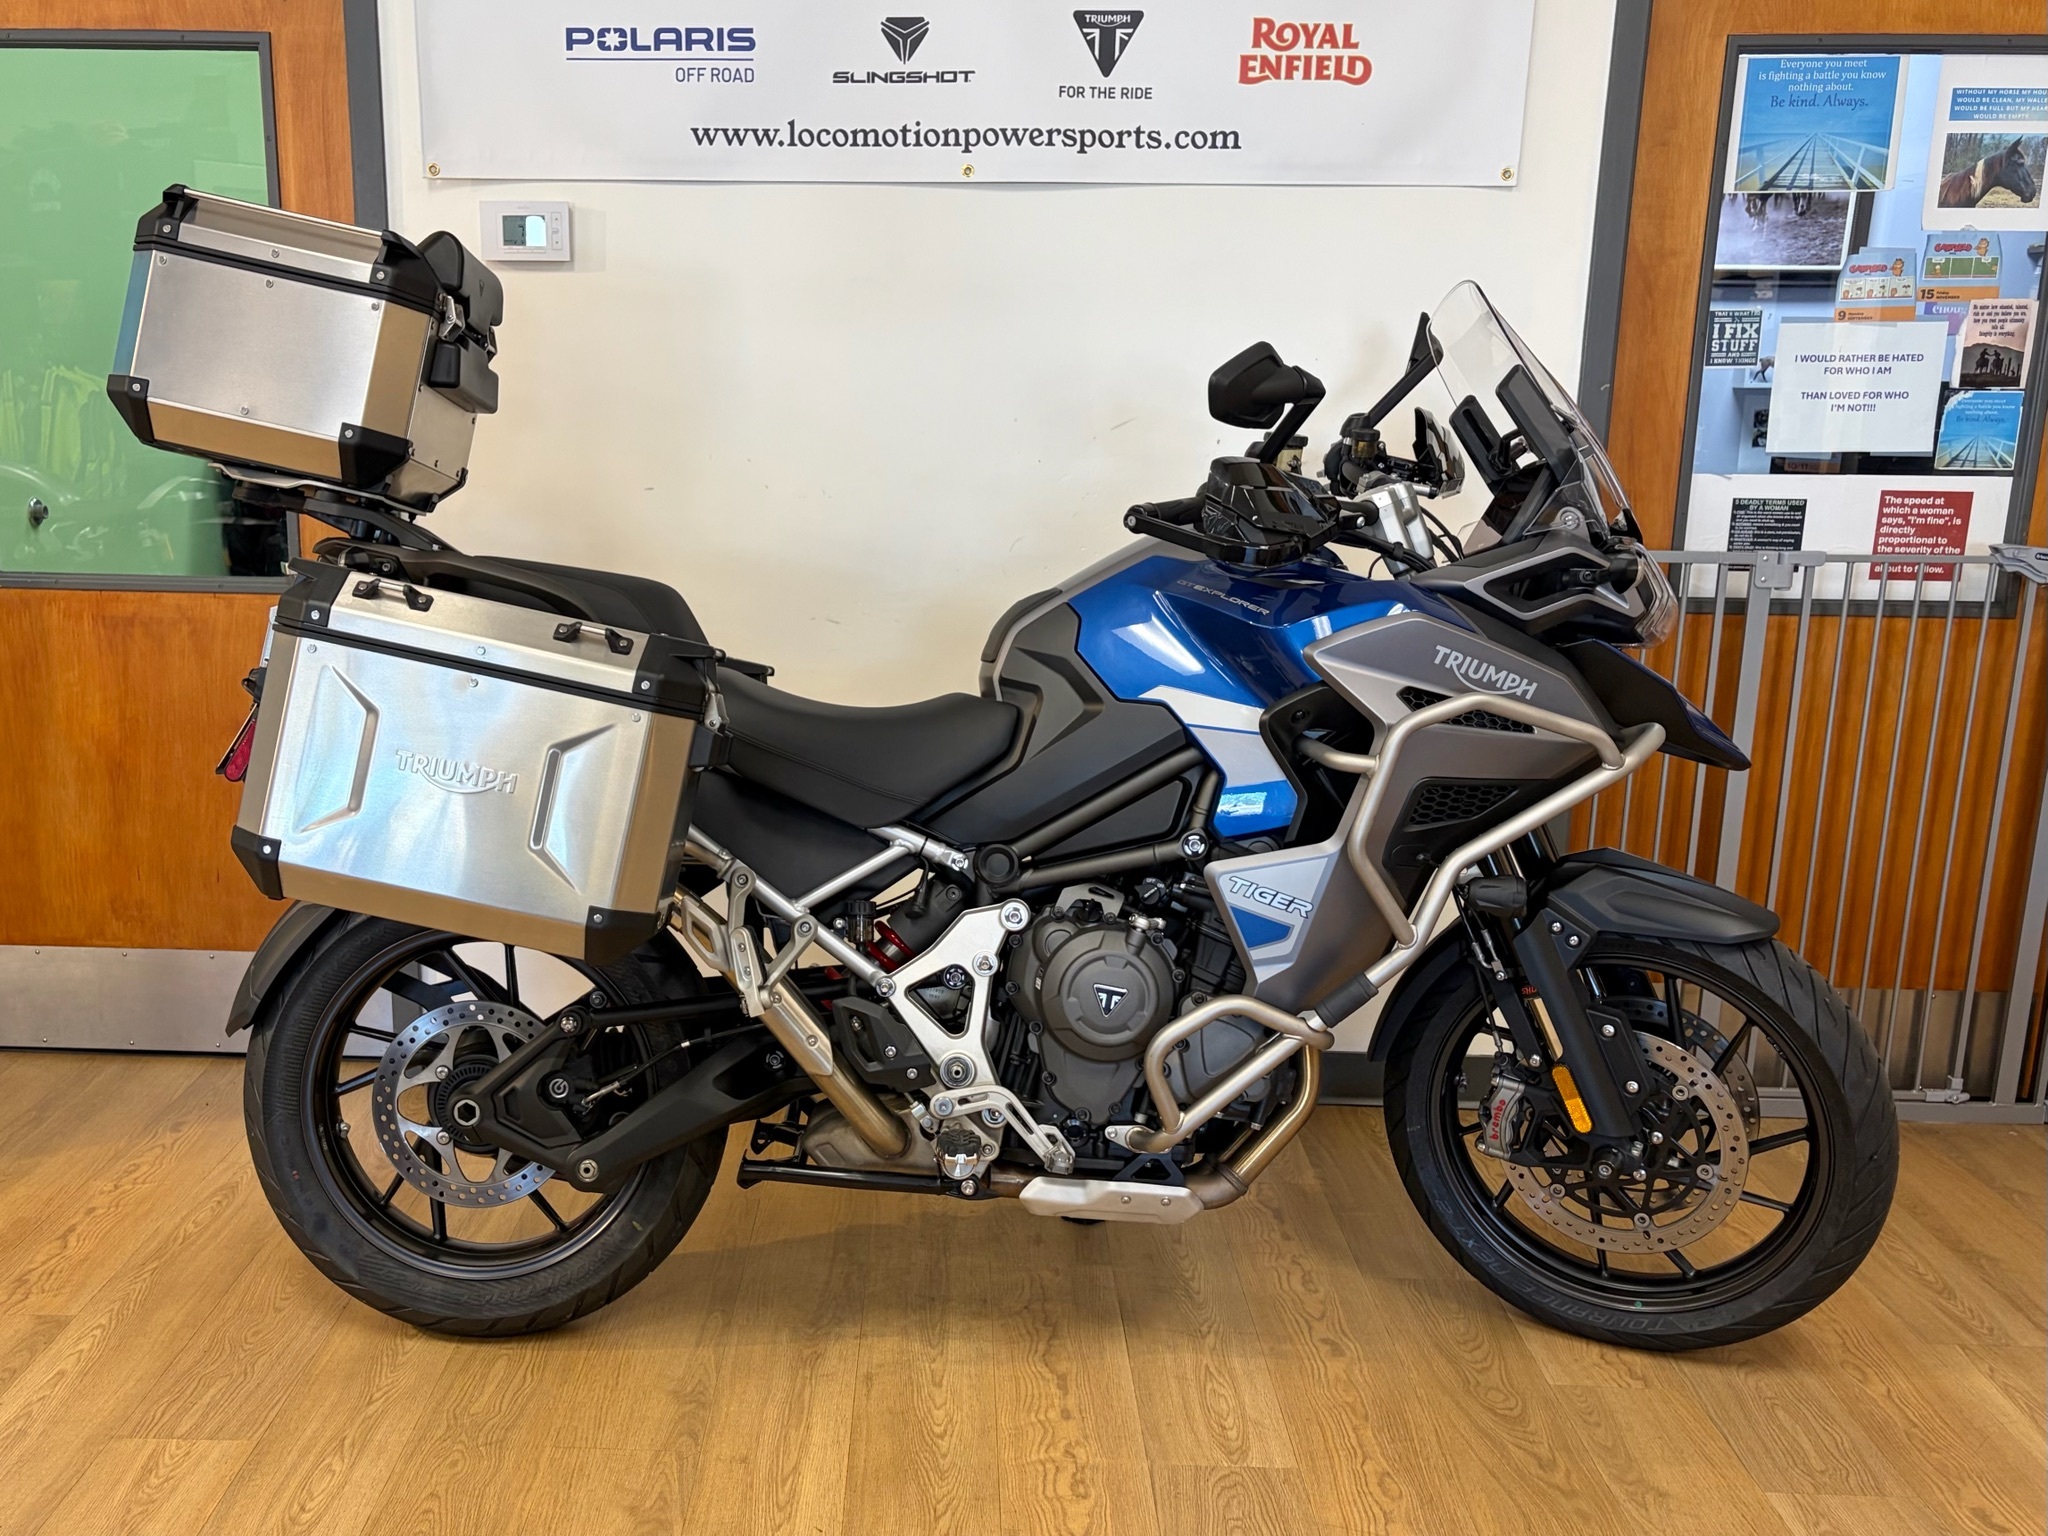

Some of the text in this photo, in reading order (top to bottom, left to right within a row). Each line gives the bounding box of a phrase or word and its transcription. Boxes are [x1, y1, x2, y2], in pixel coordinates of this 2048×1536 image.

[1084, 14, 1131, 26] TRIUMPH
[566, 27, 756, 52] POLARIS
[1251, 17, 1360, 52] ROYAL
[1238, 54, 1373, 86] ENFIELD
[1780, 60, 1822, 70] Everyone
[1825, 60, 1842, 70] you
[674, 68, 756, 83] OFF ROAD
[832, 70, 976, 84] SLINGSHOT
[1758, 72, 1766, 80] is
[1768, 71, 1803, 82] fighting
[1813, 71, 1840, 80] battle
[1841, 72, 1858, 81] you
[1861, 70, 1886, 79] know
[1058, 85, 1153, 100] FOR THE RIDE
[1788, 82, 1854, 93] nothing about.
[1770, 92, 1869, 110] Be kind. Always.
[690, 118, 1242, 154] www.locomotionpowersports.com
[1920, 289, 1934, 299] 15
[1838, 310, 1846, 320] 9
[1712, 323, 1759, 339] I FIX
[1711, 339, 1758, 352] STUFF
[1800, 355, 1836, 363] WOULD
[1838, 354, 1876, 362] RATHER
[1892, 354, 1924, 362] HATED
[1885, 391, 1909, 399] WHO
[1884, 496, 1902, 504] The
[1904, 497, 1933, 506] speed
[1882, 517, 1905, 525] says,
[1927, 517, 1951, 526] fine",
[1880, 526, 1916, 535] directly
[1878, 536, 1936, 545] proportional
[1895, 546, 1932, 555] severity
[1914, 565, 1944, 573] fllow.
[1434, 645, 1538, 700] TRIUMPH
[396, 750, 518, 794] TRIUMPH
[1229, 876, 1314, 919] TIGER
[1490, 1099, 1506, 1140] brembo
